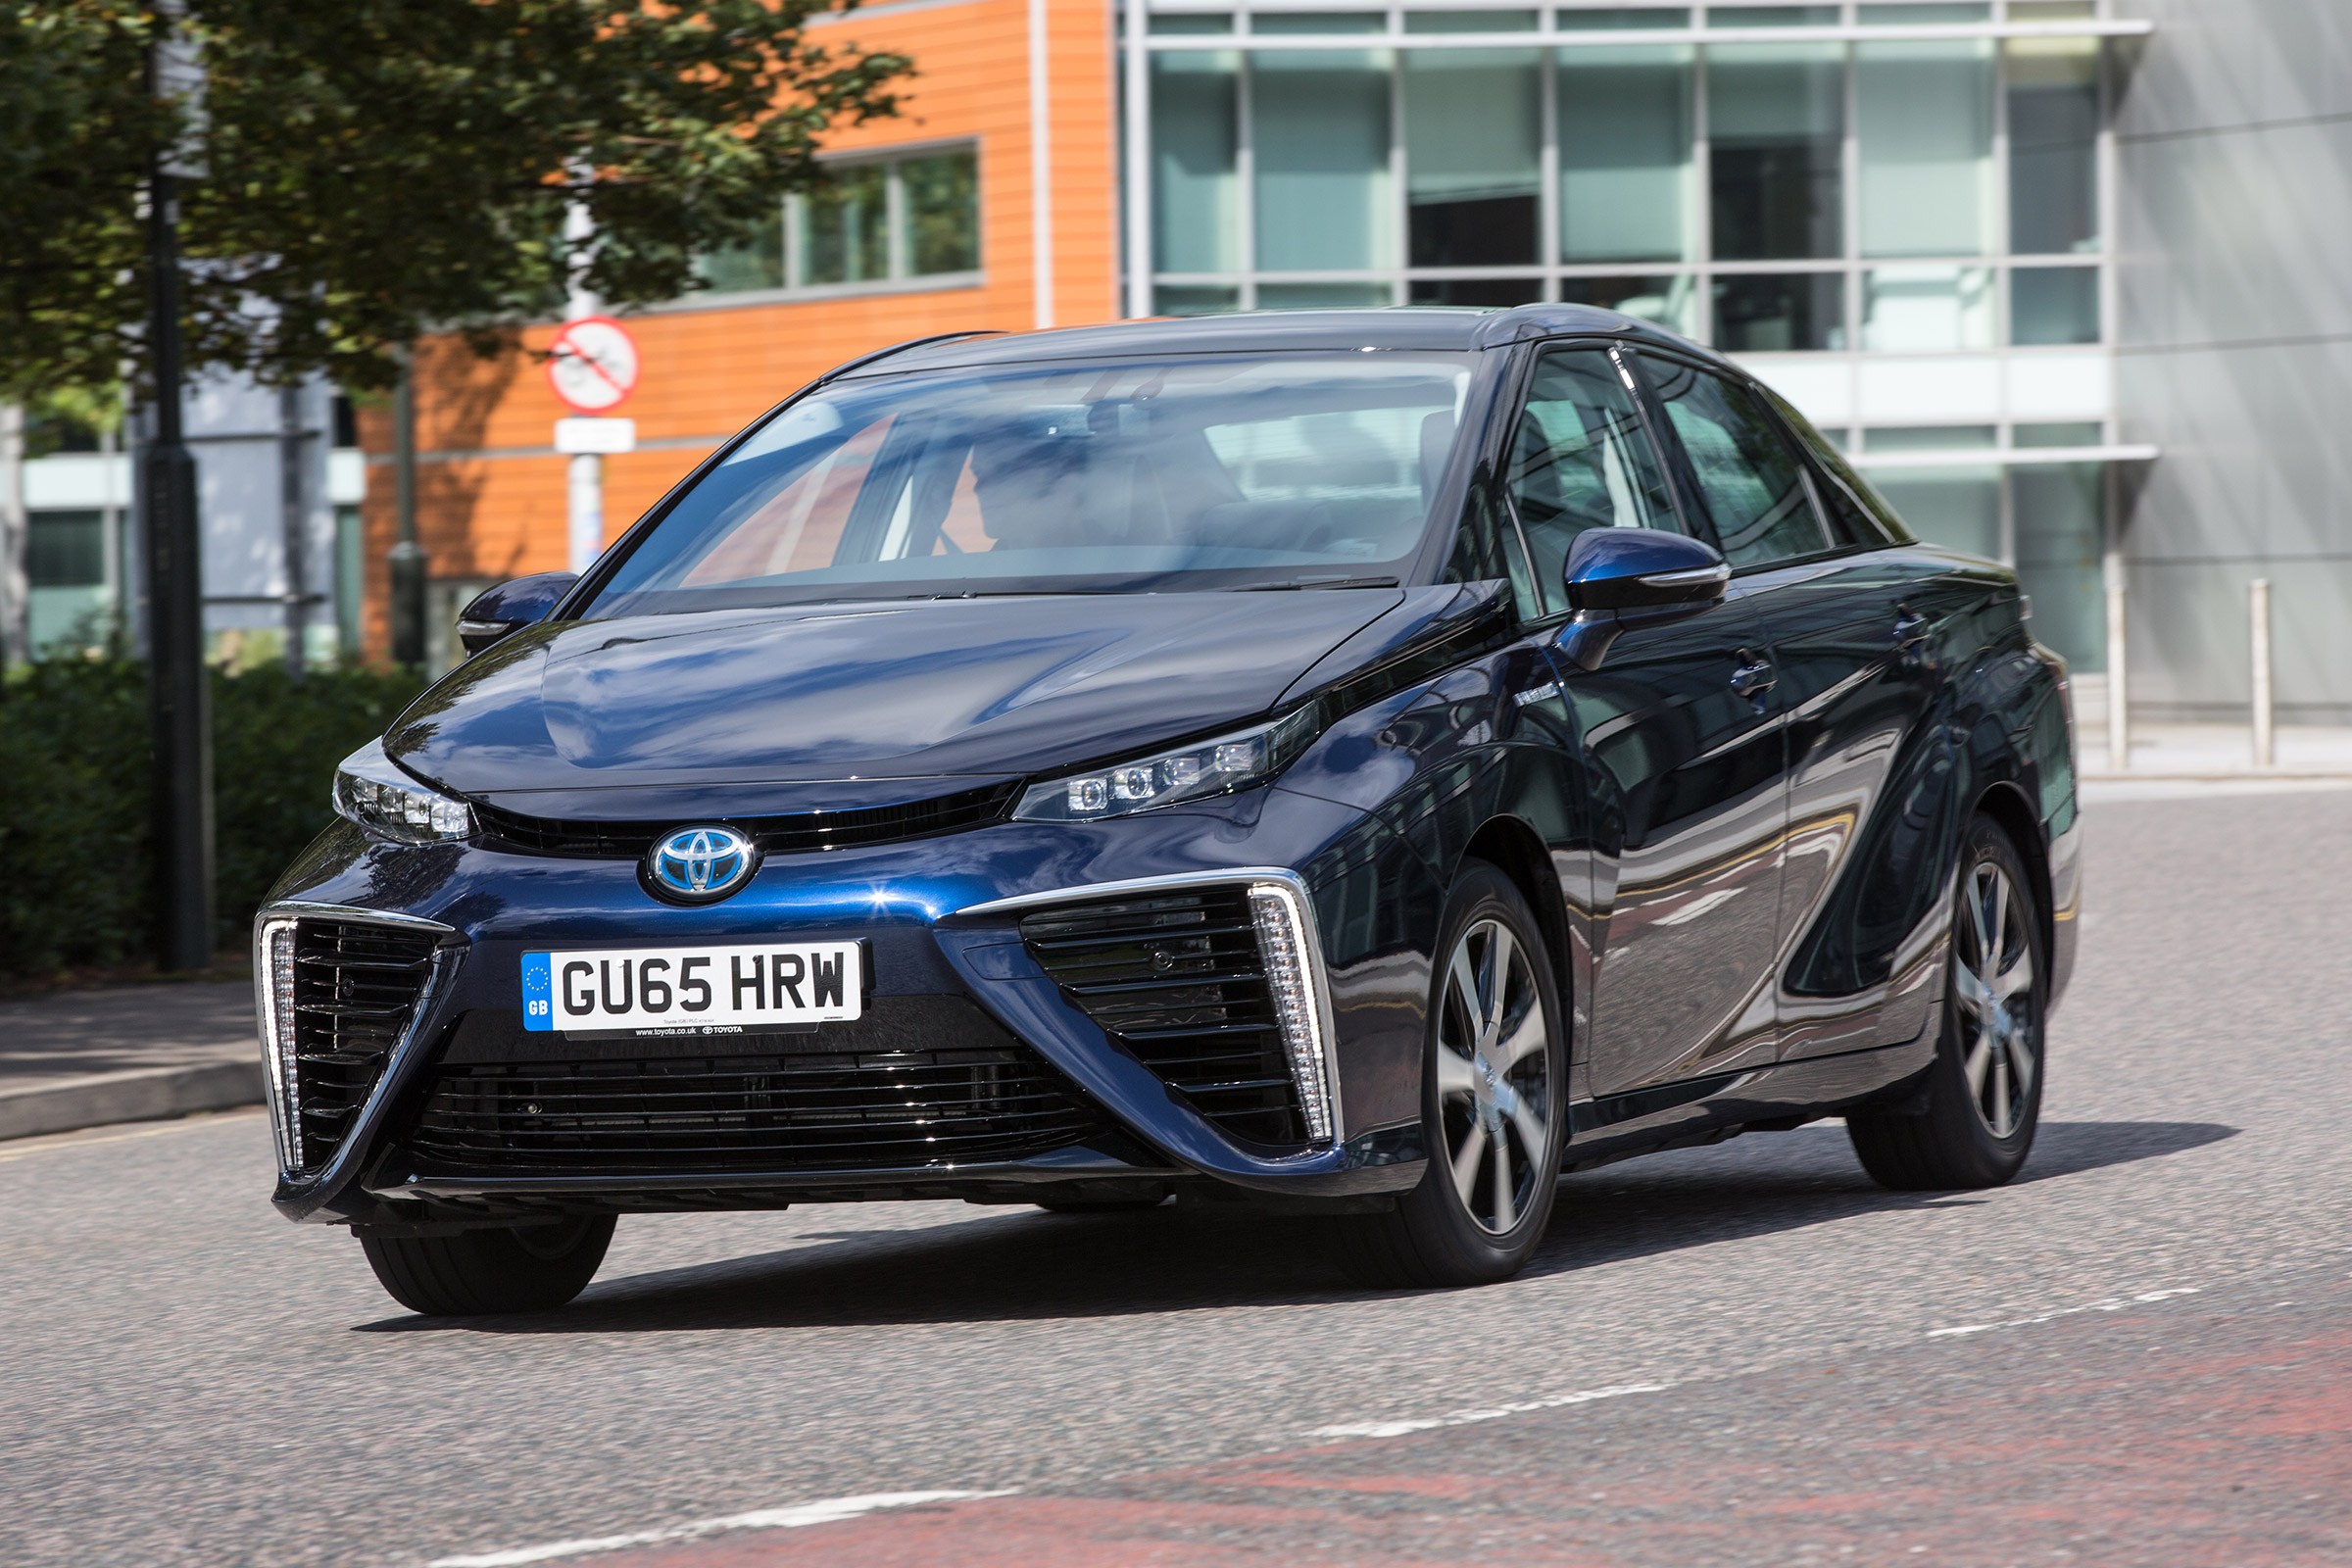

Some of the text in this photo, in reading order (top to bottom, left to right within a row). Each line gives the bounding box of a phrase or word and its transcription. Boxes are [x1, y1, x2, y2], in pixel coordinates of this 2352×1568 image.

[563, 952, 844, 1016] GU65 HRW
[529, 1000, 548, 1015] GB
[636, 1027, 696, 1037] www.toyota.co.uk
